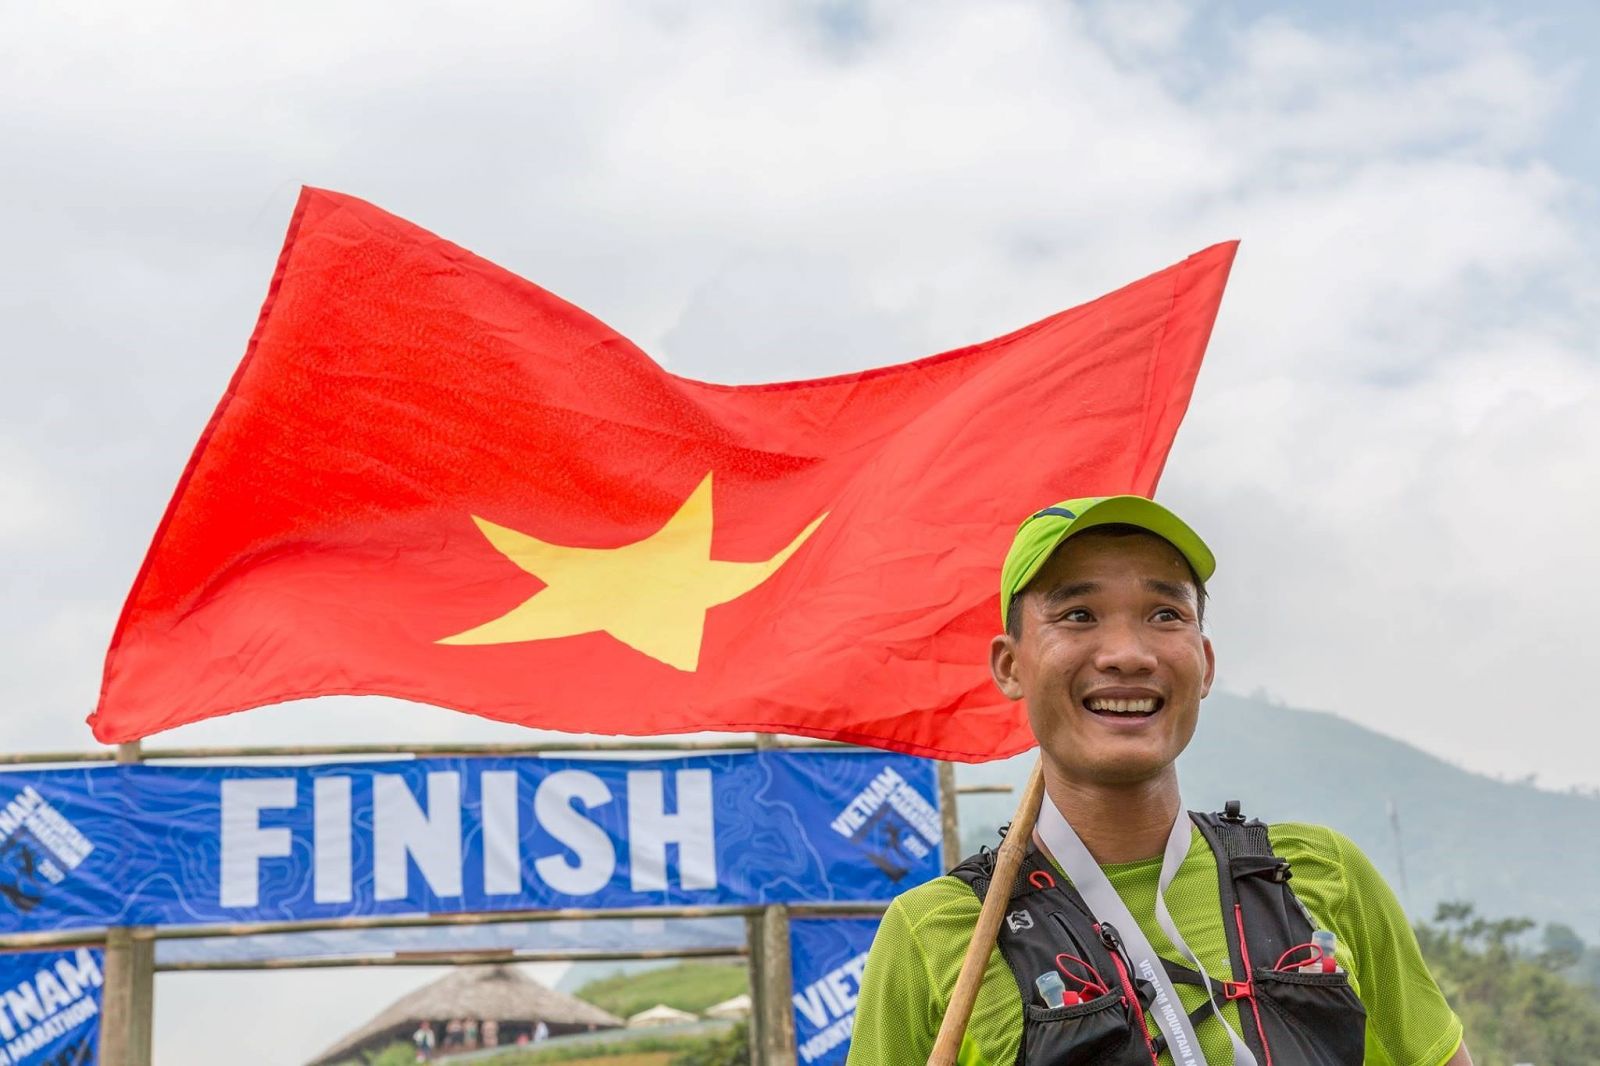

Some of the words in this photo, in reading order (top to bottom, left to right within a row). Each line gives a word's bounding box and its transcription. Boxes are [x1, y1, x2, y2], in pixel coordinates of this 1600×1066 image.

[220, 768, 717, 908] FINISH
[830, 766, 904, 838] VIETNAM
[1161, 1004, 1193, 1059] MOUNTAIN
